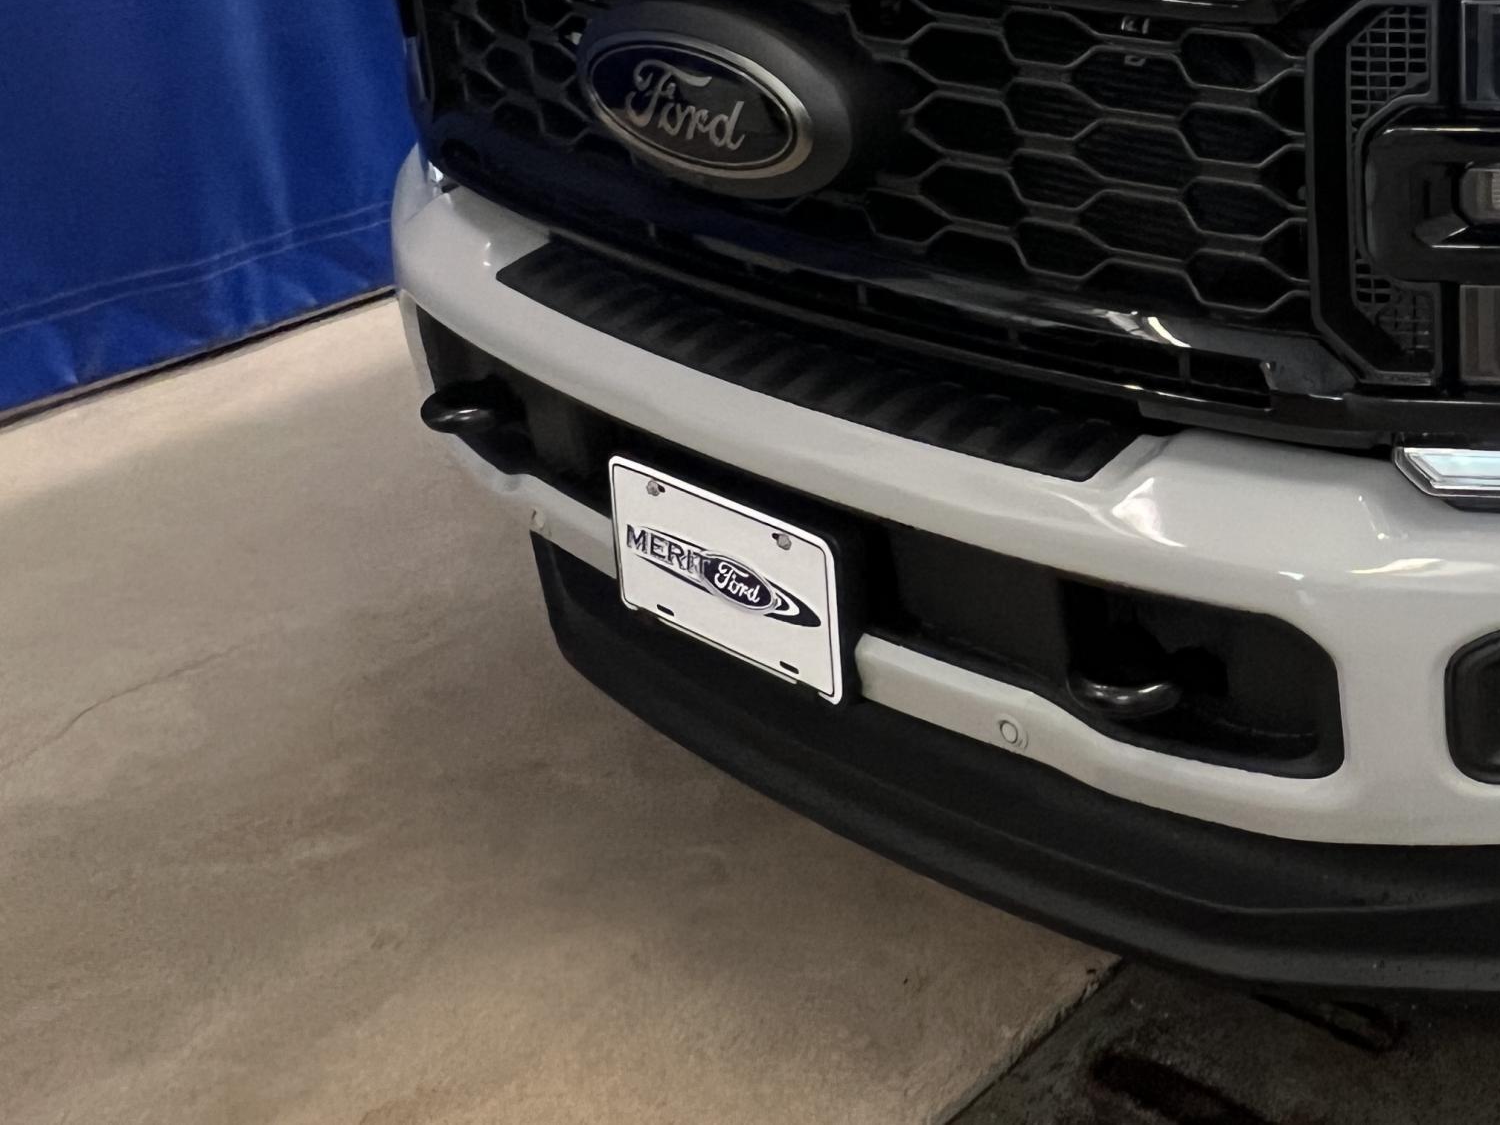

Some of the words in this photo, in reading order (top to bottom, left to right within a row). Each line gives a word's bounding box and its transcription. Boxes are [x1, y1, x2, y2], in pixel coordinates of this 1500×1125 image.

[624, 59, 747, 151] Ford
[626, 524, 711, 574] MERIT
[713, 561, 761, 605] Ford
